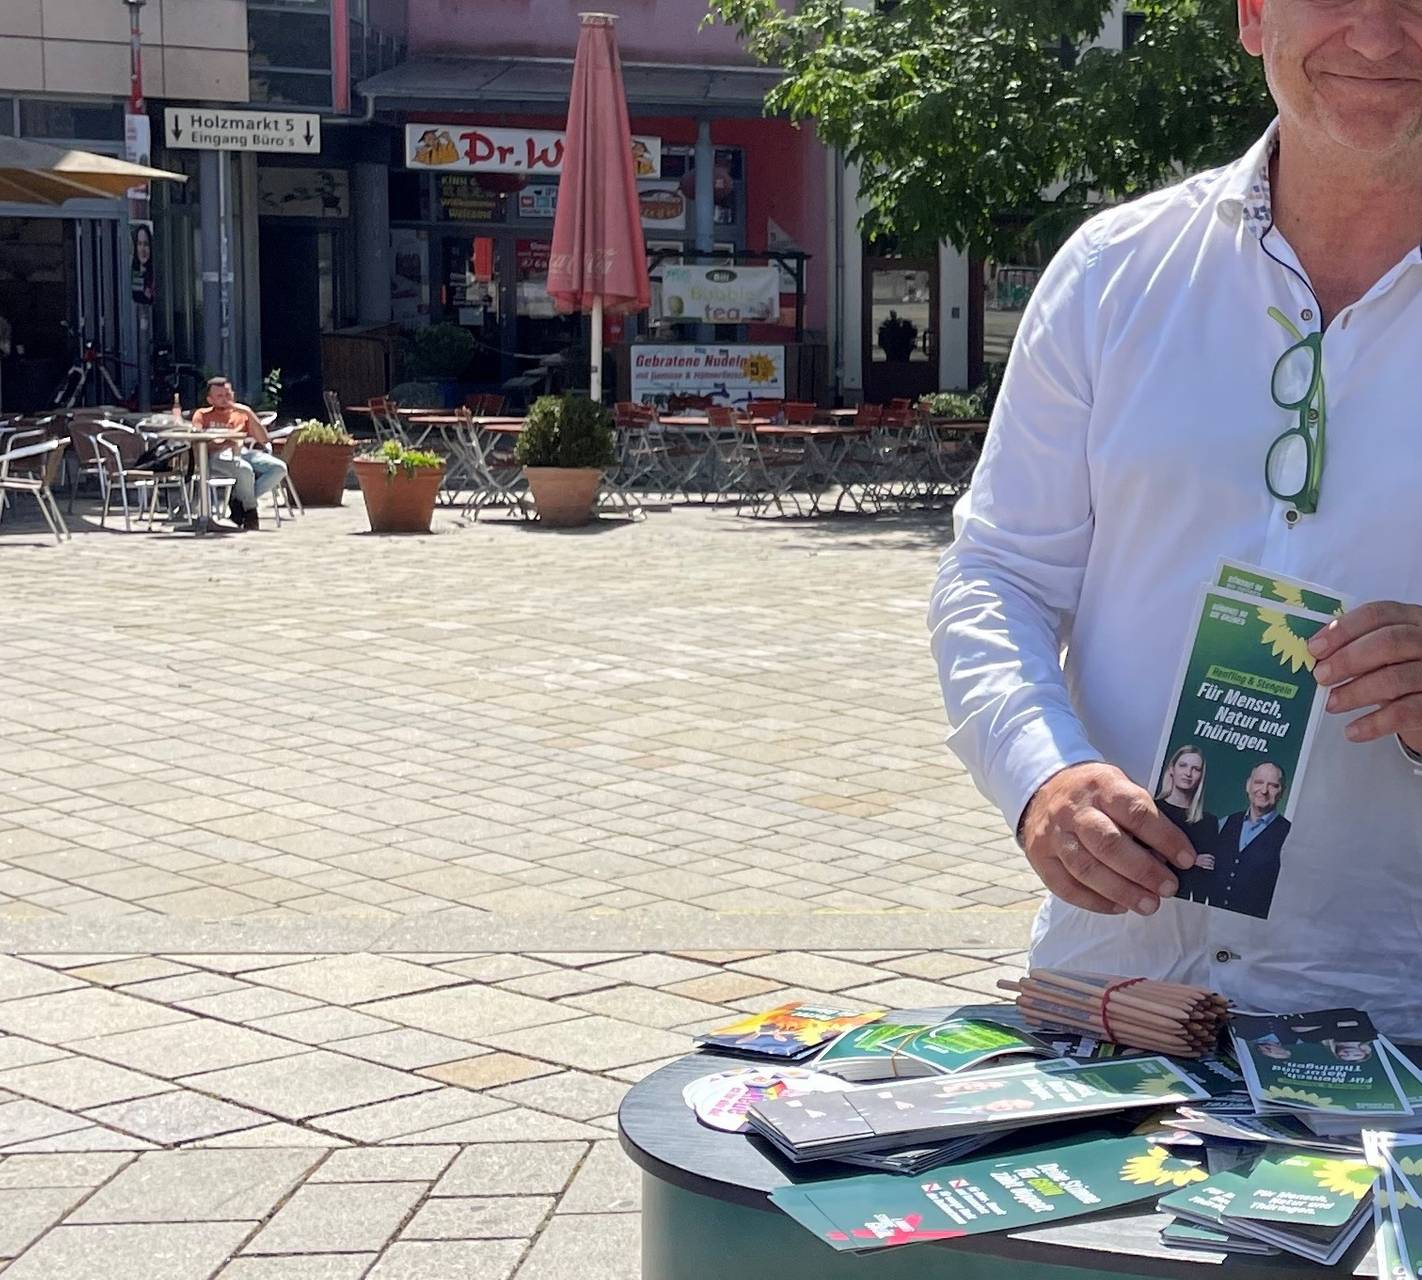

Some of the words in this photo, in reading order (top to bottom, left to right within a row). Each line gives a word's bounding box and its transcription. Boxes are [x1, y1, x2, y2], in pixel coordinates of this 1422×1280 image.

[191, 115, 280, 132] Holzmarkt
[286, 118, 295, 132] 5
[191, 131, 249, 147] Eingang
[526, 138, 565, 169] W
[704, 303, 741, 321] tea
[635, 354, 700, 368] Gebratene
[1197, 682, 1224, 701] Für
[1223, 688, 1282, 719] Mensch,
[1214, 705, 1259, 730] Natur
[1258, 719, 1290, 738] und
[1193, 719, 1269, 753] Thüringen.
